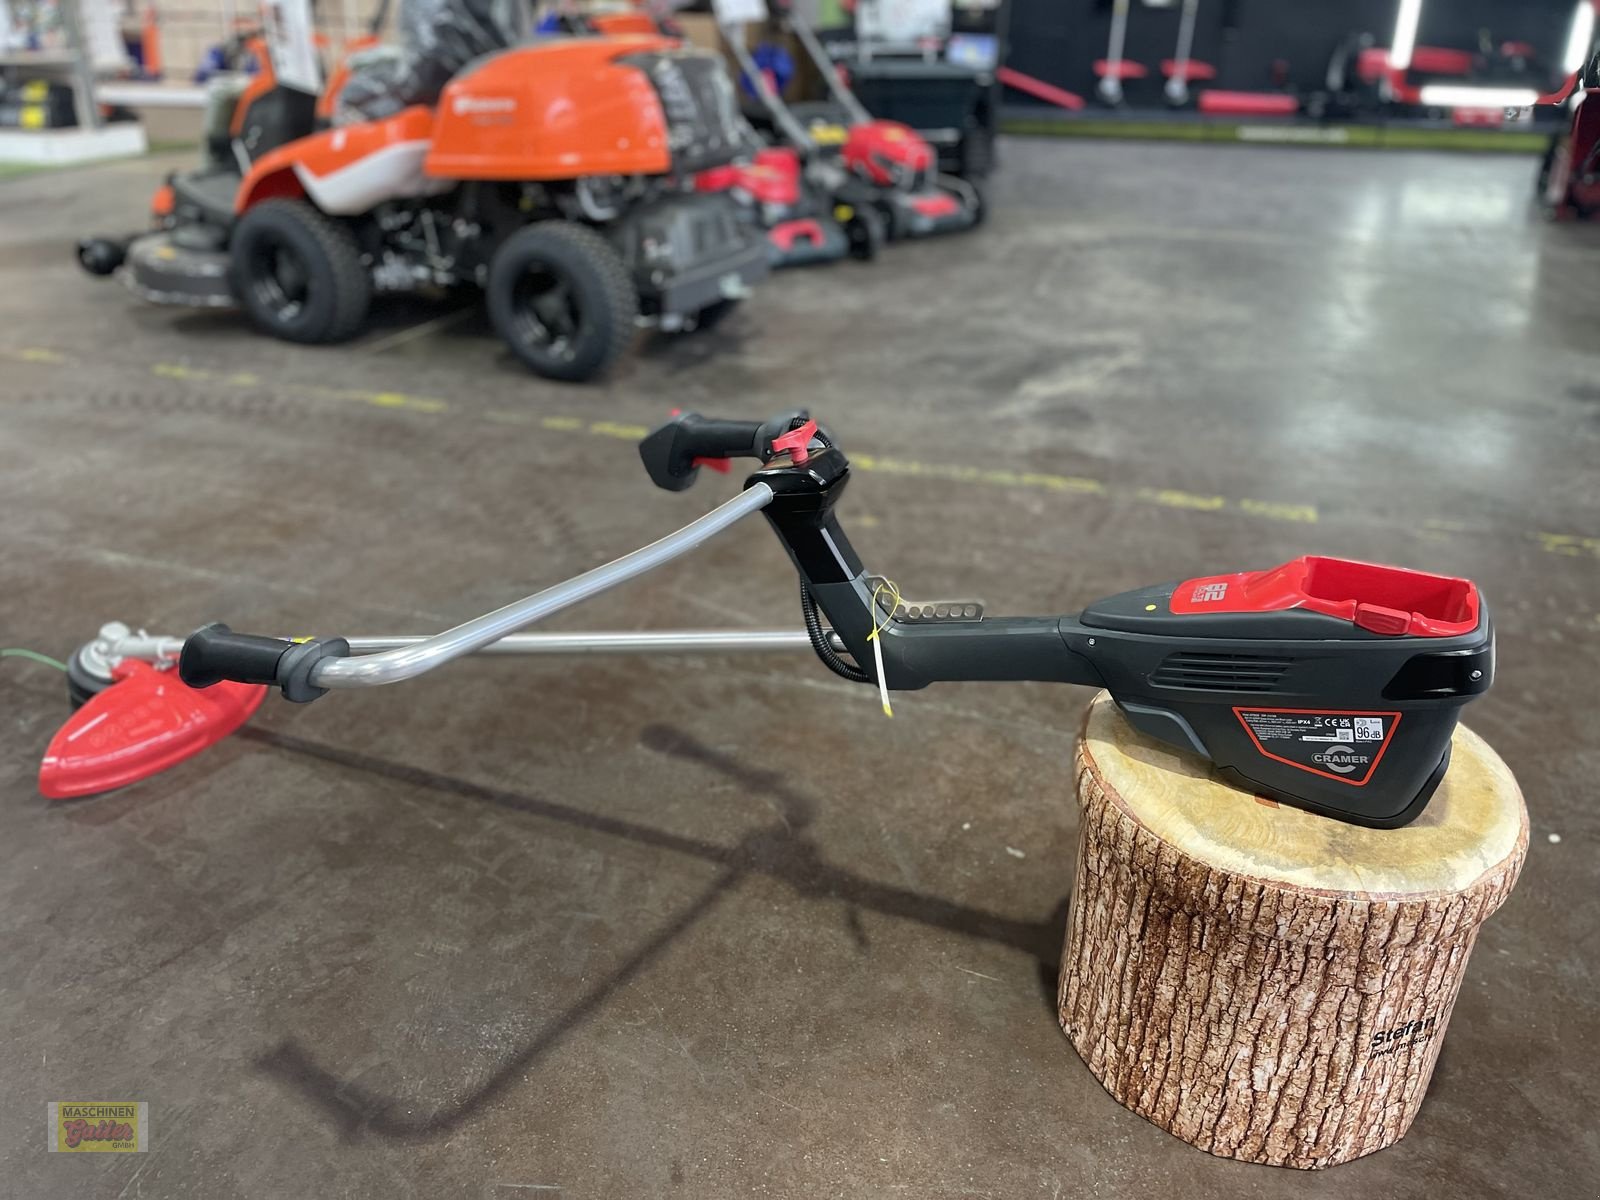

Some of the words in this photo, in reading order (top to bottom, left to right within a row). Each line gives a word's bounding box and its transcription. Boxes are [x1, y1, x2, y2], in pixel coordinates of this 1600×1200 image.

[1324, 718, 1338, 727] CE
[1356, 726, 1370, 738] 96
[1370, 730, 1381, 738] dB
[1313, 754, 1369, 764] CRAMER
[1371, 1017, 1436, 1047] Stefan
